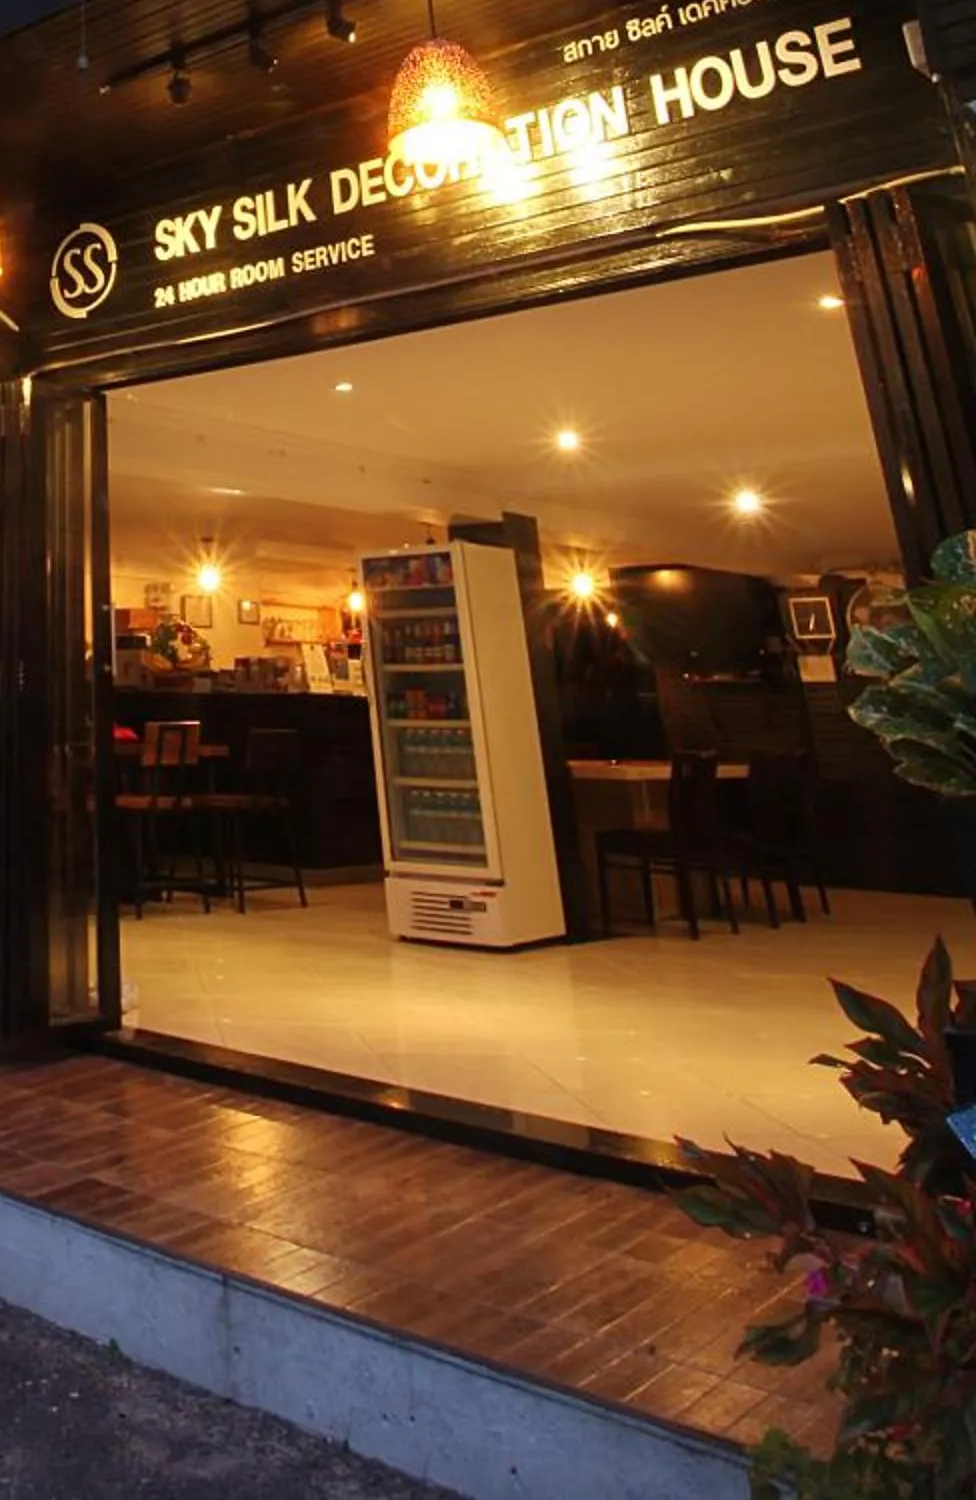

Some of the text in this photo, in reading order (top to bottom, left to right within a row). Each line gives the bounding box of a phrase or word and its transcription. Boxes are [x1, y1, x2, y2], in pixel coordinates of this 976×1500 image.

[153, 205, 223, 262] SKY
[232, 176, 317, 241] SILK
[649, 16, 862, 125] HOUSE
[153, 234, 375, 309] 24 HOUR ROOM SERVICE
